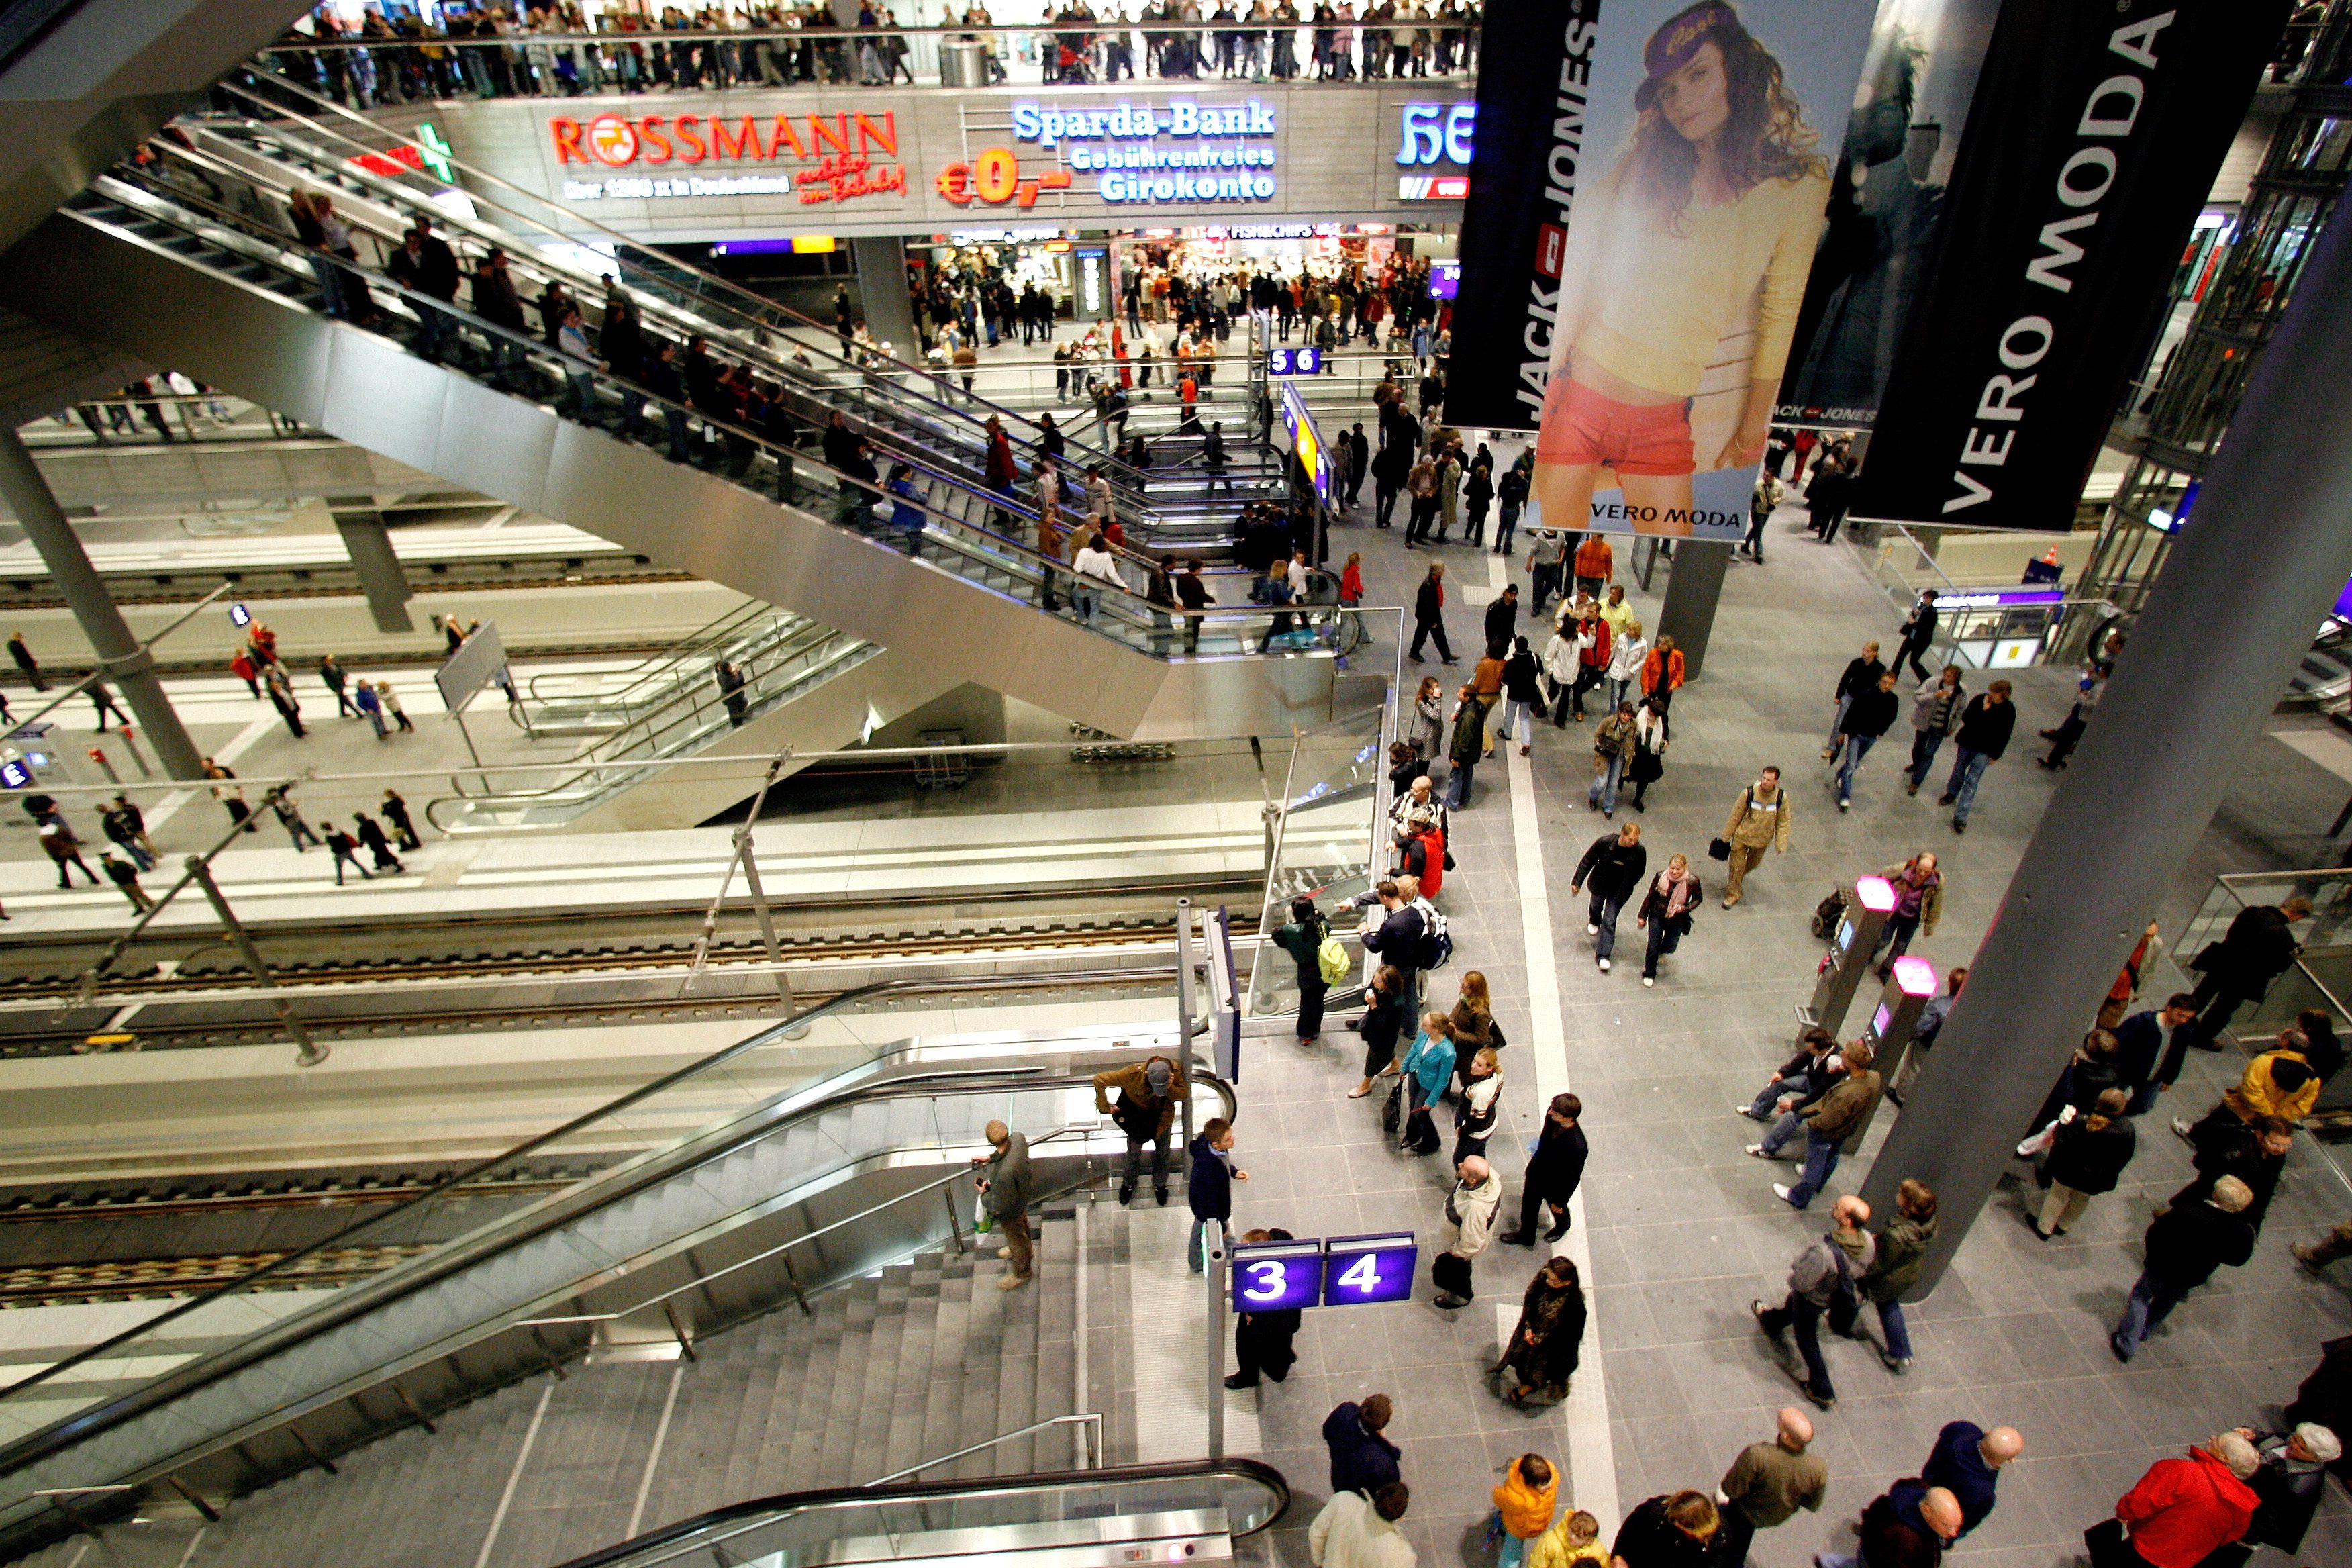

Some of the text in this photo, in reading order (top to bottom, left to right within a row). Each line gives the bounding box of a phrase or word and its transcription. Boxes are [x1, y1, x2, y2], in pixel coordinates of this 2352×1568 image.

[549, 109, 898, 167] ROSSMANN
[1014, 100, 1276, 147] Sparda-Bank
[1071, 145, 1275, 171] Gebührenfreies
[829, 164, 908, 202] Bahnhof
[1099, 170, 1275, 202] Girokonto
[1516, 18, 1597, 422] JACK JONES
[1942, 315, 2053, 513] VERO
[2026, 9, 2177, 293] MODA
[1271, 350, 1287, 371] 5
[1297, 349, 1314, 371] 6
[1820, 407, 1877, 422] JONES
[1591, 503, 1740, 528] VERO MODA
[3, 763, 26, 786] E
[1244, 1260, 1287, 1301] 3
[1338, 1253, 1381, 1293] 4
